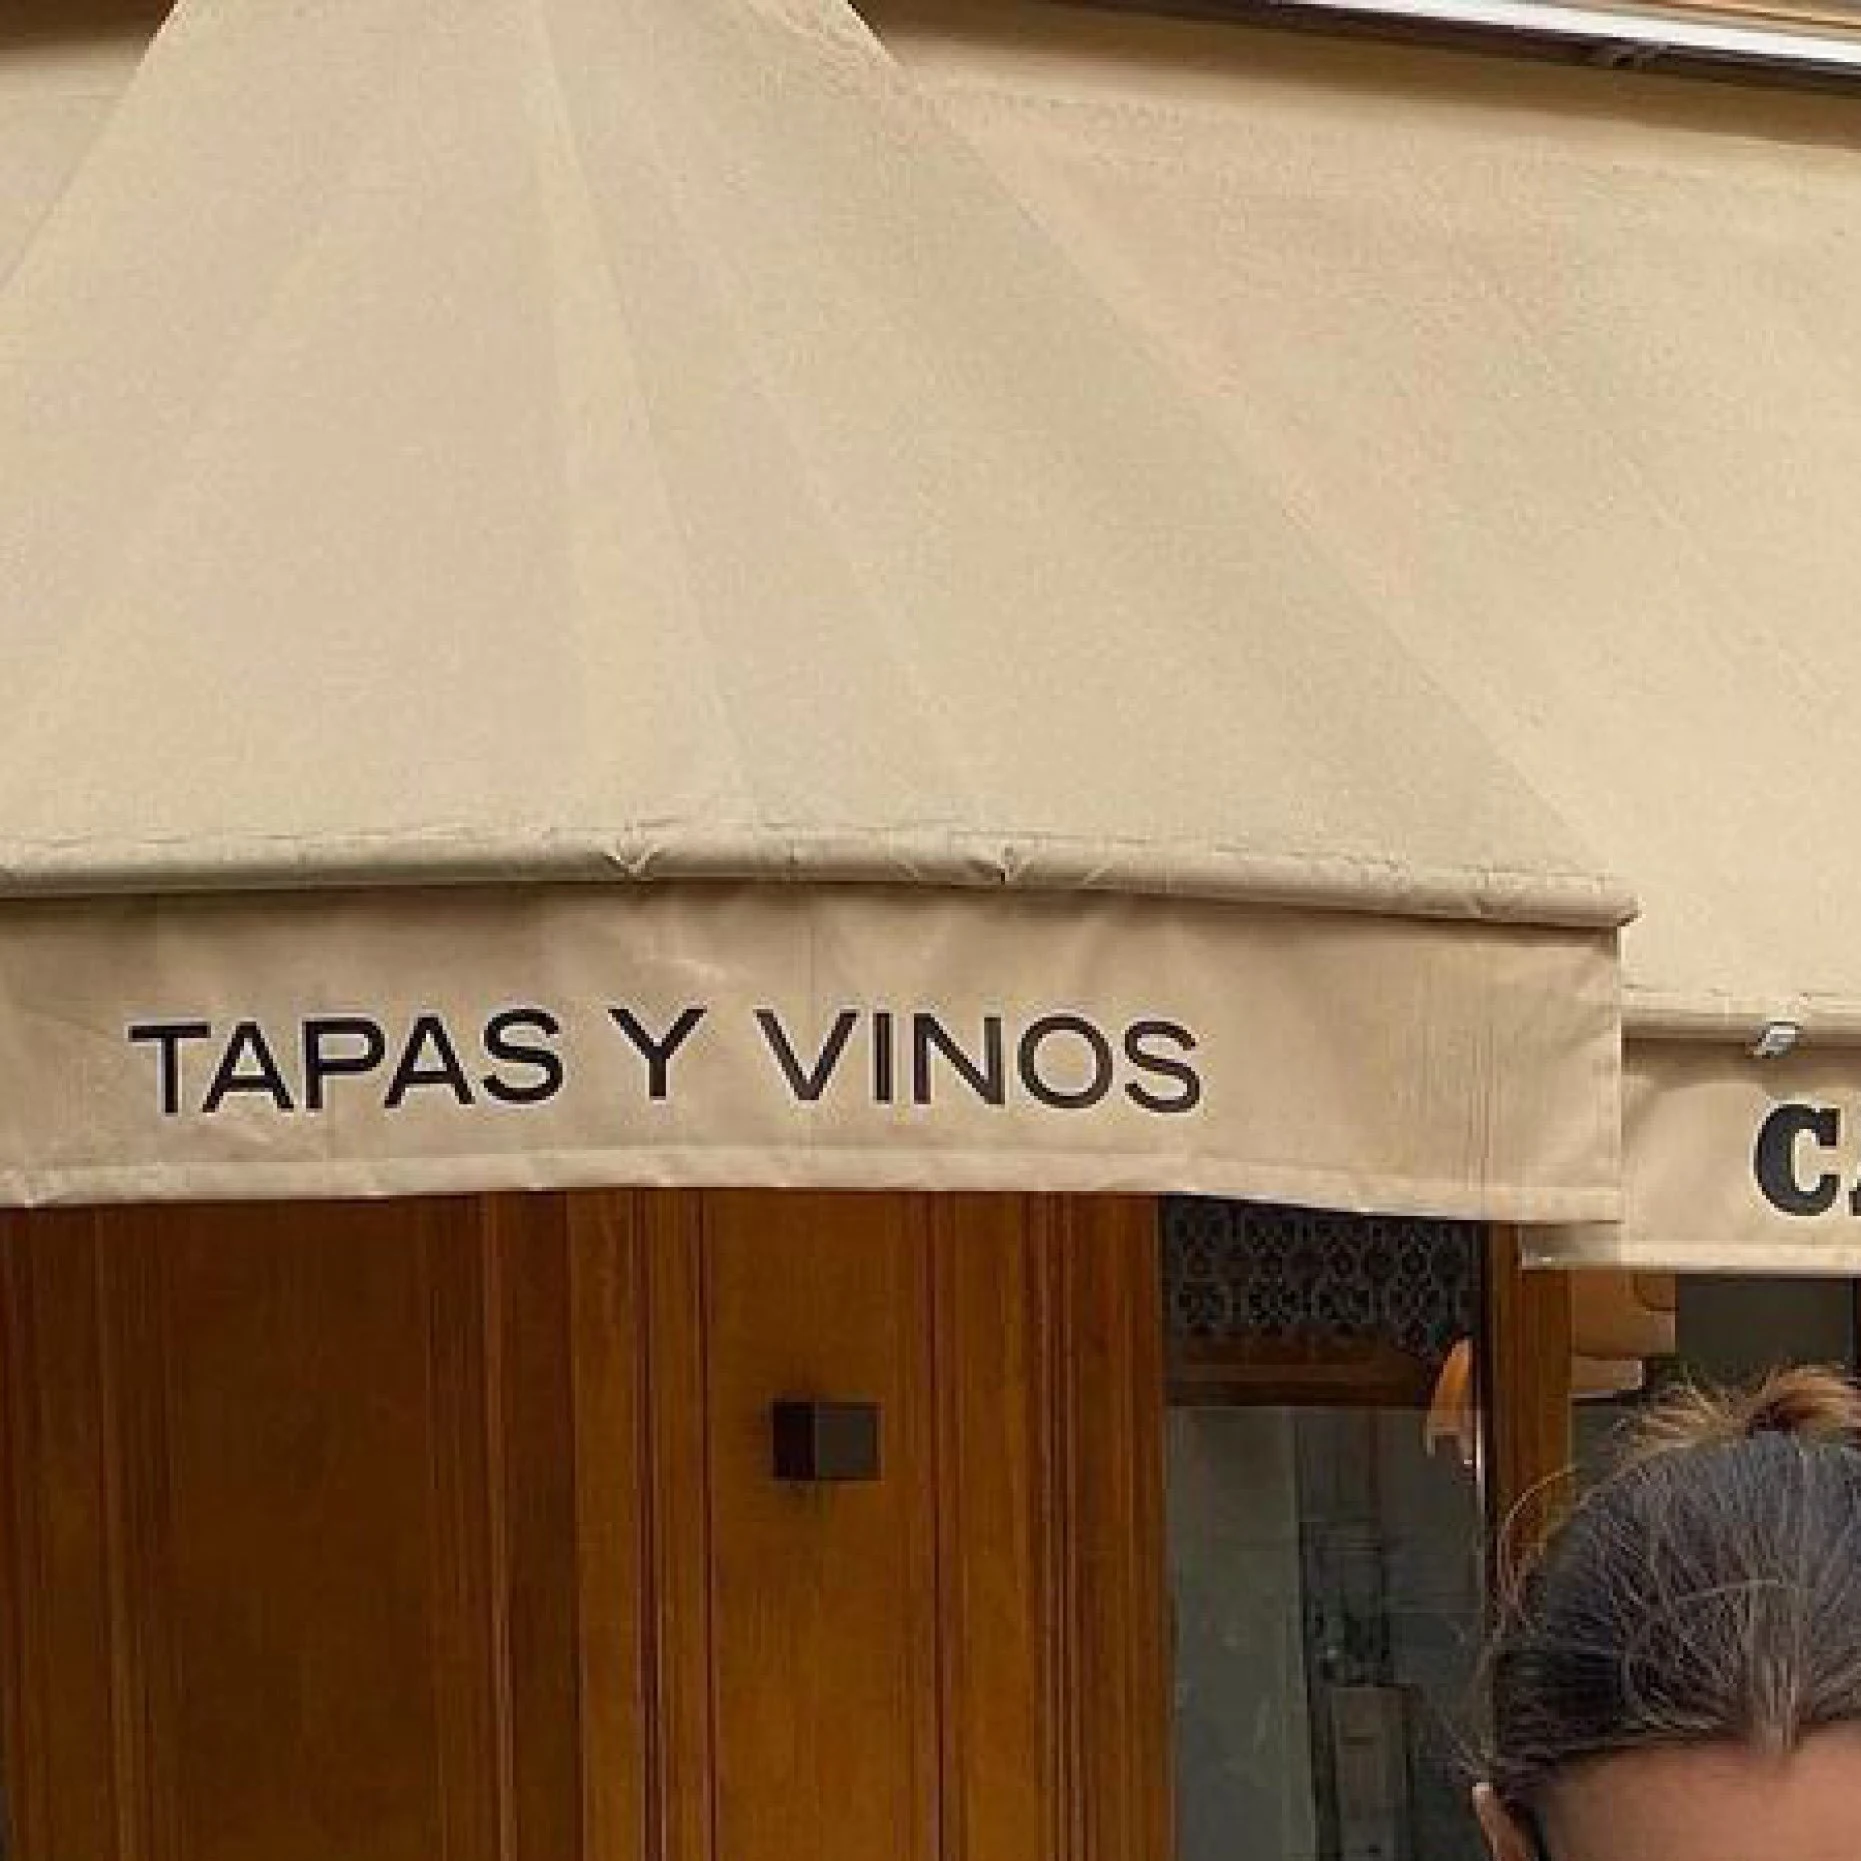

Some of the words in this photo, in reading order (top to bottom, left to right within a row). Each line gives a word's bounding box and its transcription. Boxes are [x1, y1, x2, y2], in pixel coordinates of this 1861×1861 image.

[127, 1007, 565, 1115] TAPAS
[607, 1007, 708, 1100] Y
[755, 1008, 1202, 1114] VINOS
